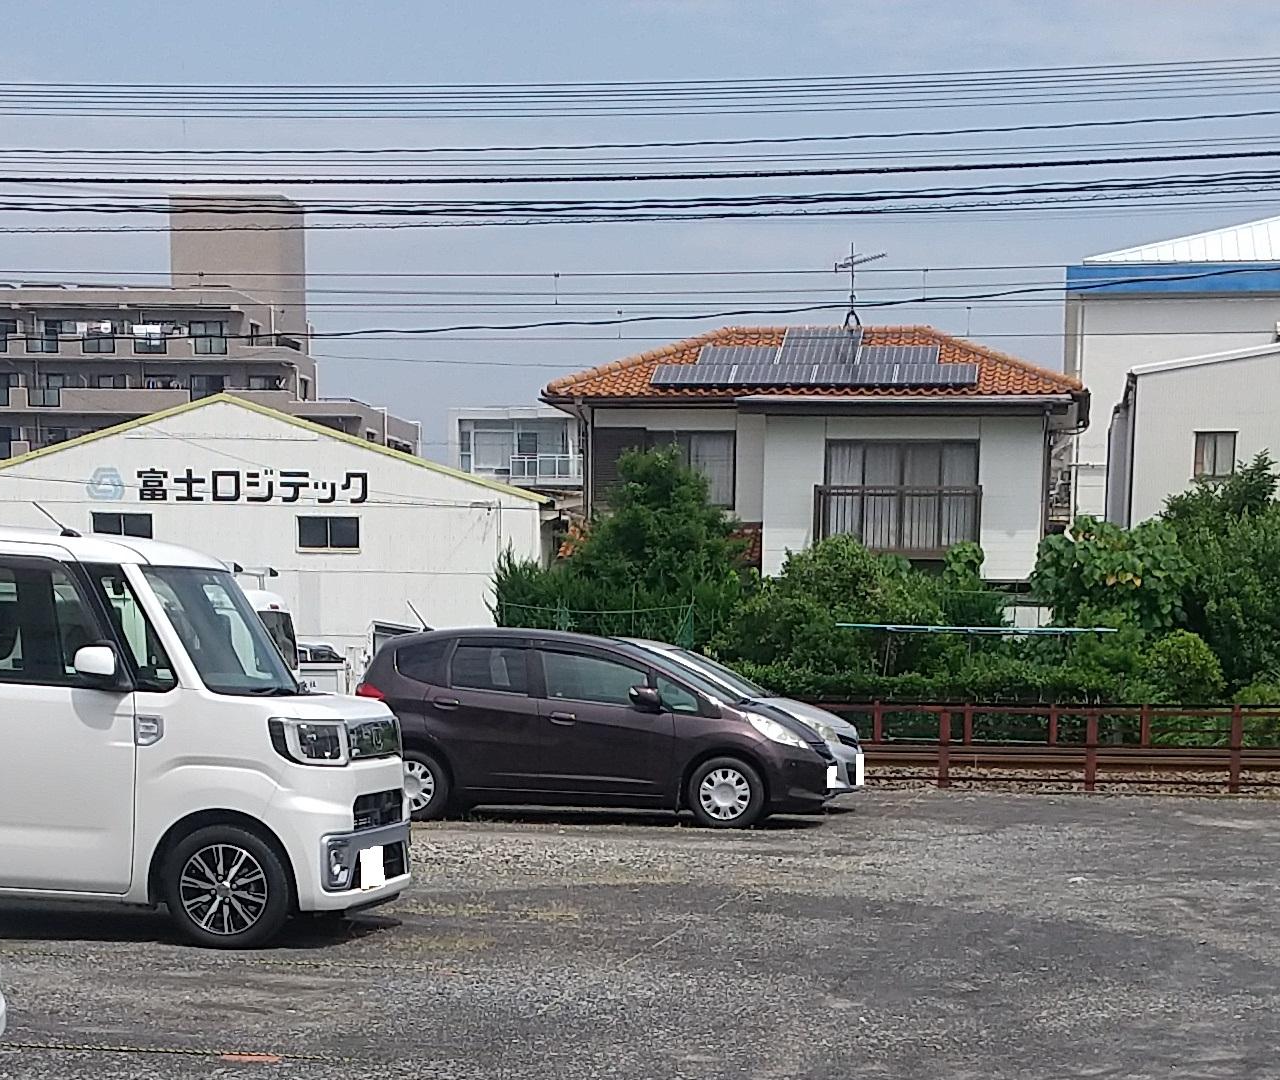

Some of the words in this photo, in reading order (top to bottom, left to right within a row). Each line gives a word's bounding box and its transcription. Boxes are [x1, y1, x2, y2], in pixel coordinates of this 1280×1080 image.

[136, 468, 368, 504] 富士ロジテック
